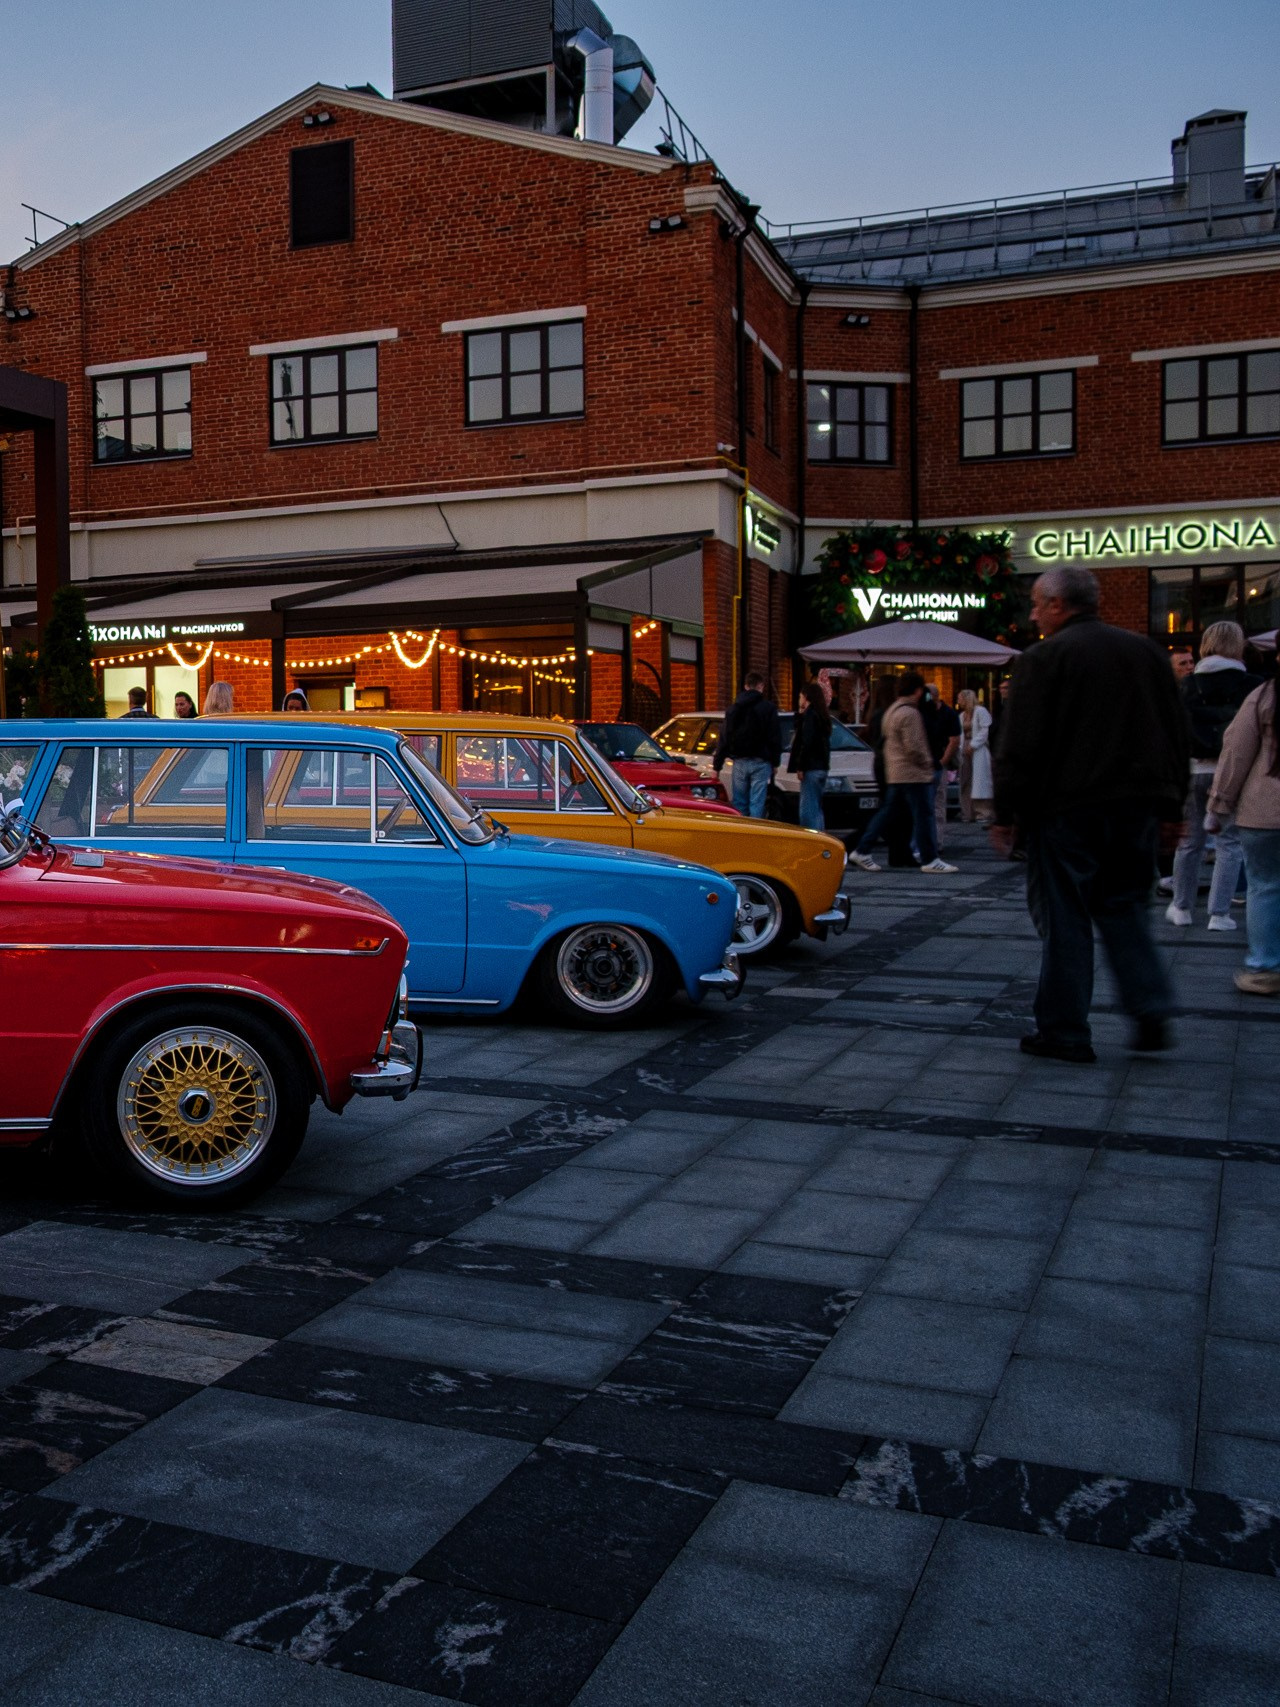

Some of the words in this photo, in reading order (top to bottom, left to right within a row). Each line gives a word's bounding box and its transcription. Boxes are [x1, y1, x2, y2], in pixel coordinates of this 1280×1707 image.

[1033, 519, 1275, 558] CHAIHONA
[879, 592, 963, 609] CHAIHONA
[77, 624, 143, 642] ЙХОНА
[180, 622, 245, 636] ВАСИЛЬЧУКОВ
